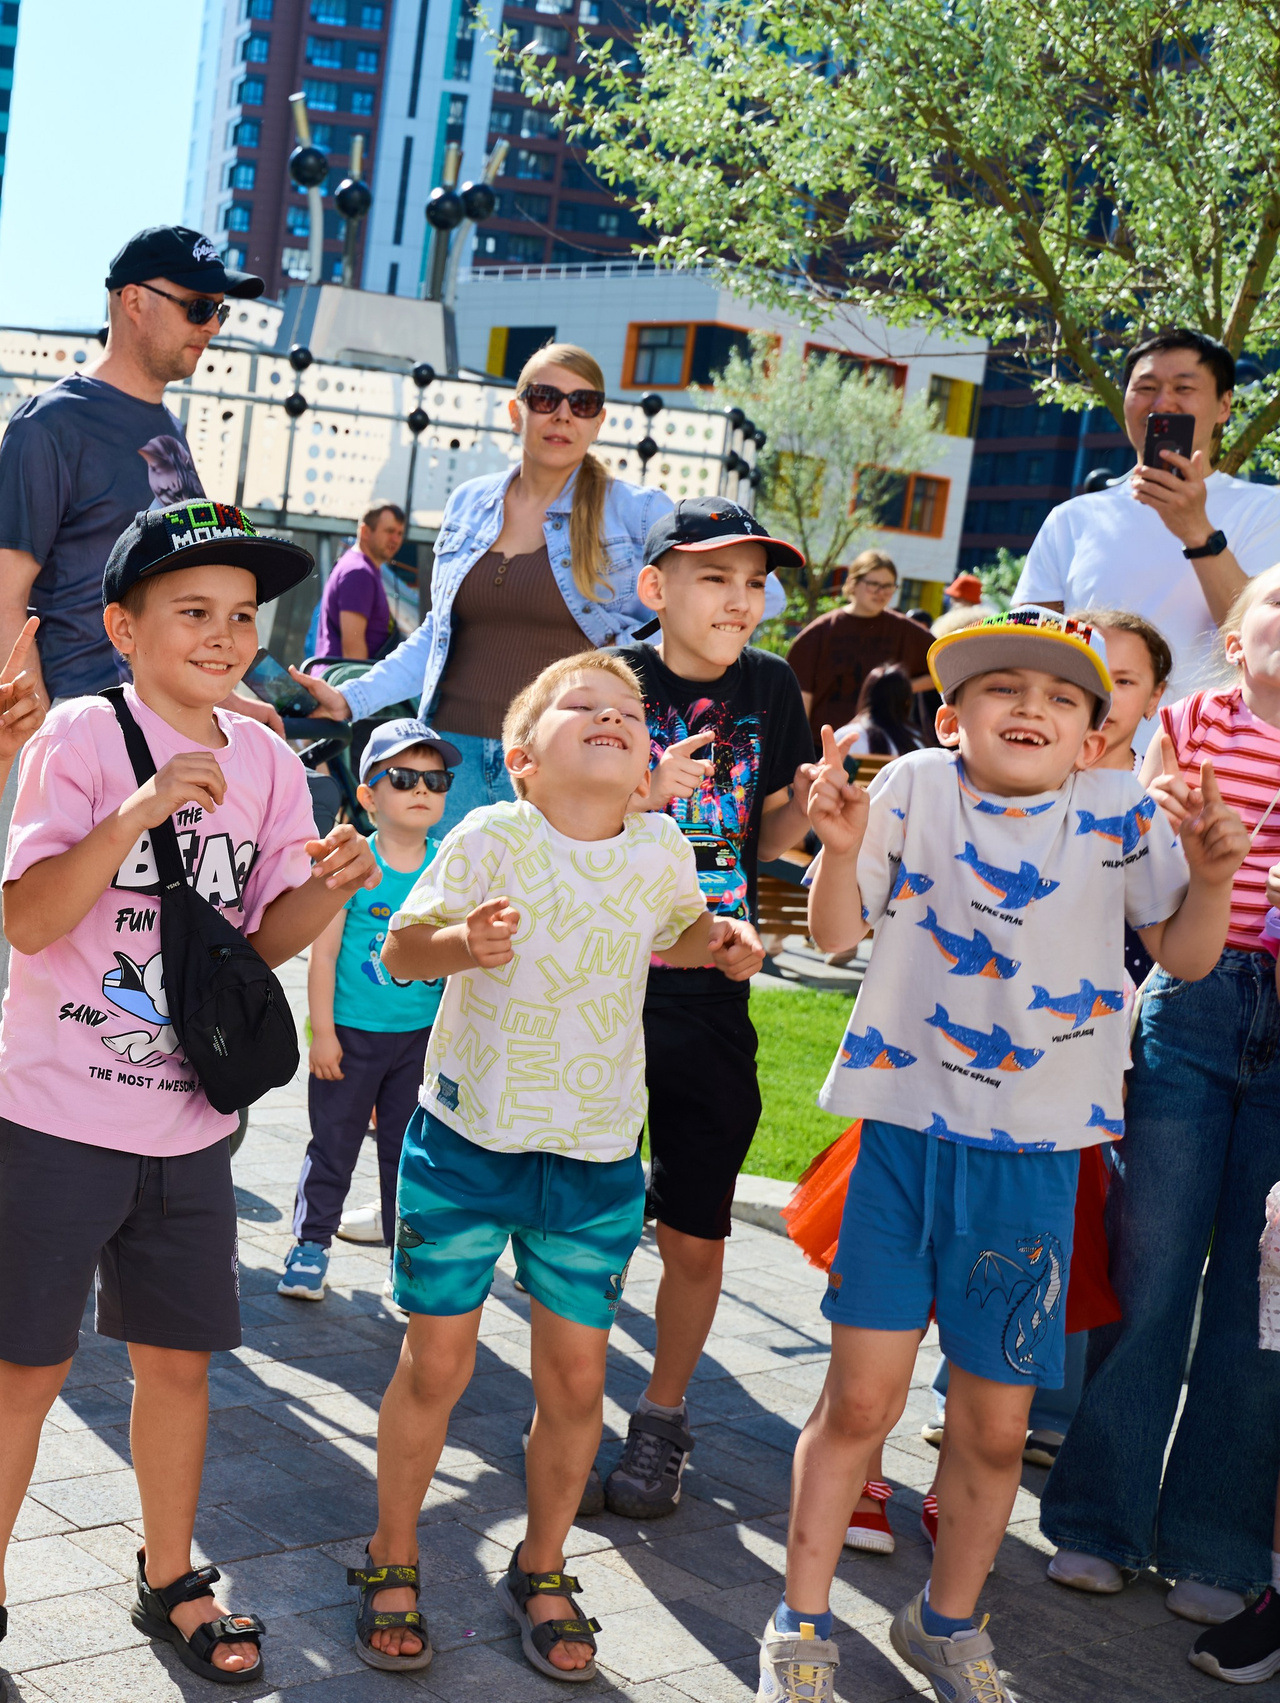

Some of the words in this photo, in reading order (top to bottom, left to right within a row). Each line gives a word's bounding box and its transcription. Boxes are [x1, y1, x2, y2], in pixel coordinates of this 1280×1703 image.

[176, 807, 203, 827] THE
[115, 908, 158, 933] FUN
[58, 1002, 109, 1028] SAND
[89, 1066, 113, 1081] THE
[117, 1072, 154, 1090] MOST
[157, 1078, 197, 1093] AWESOME
